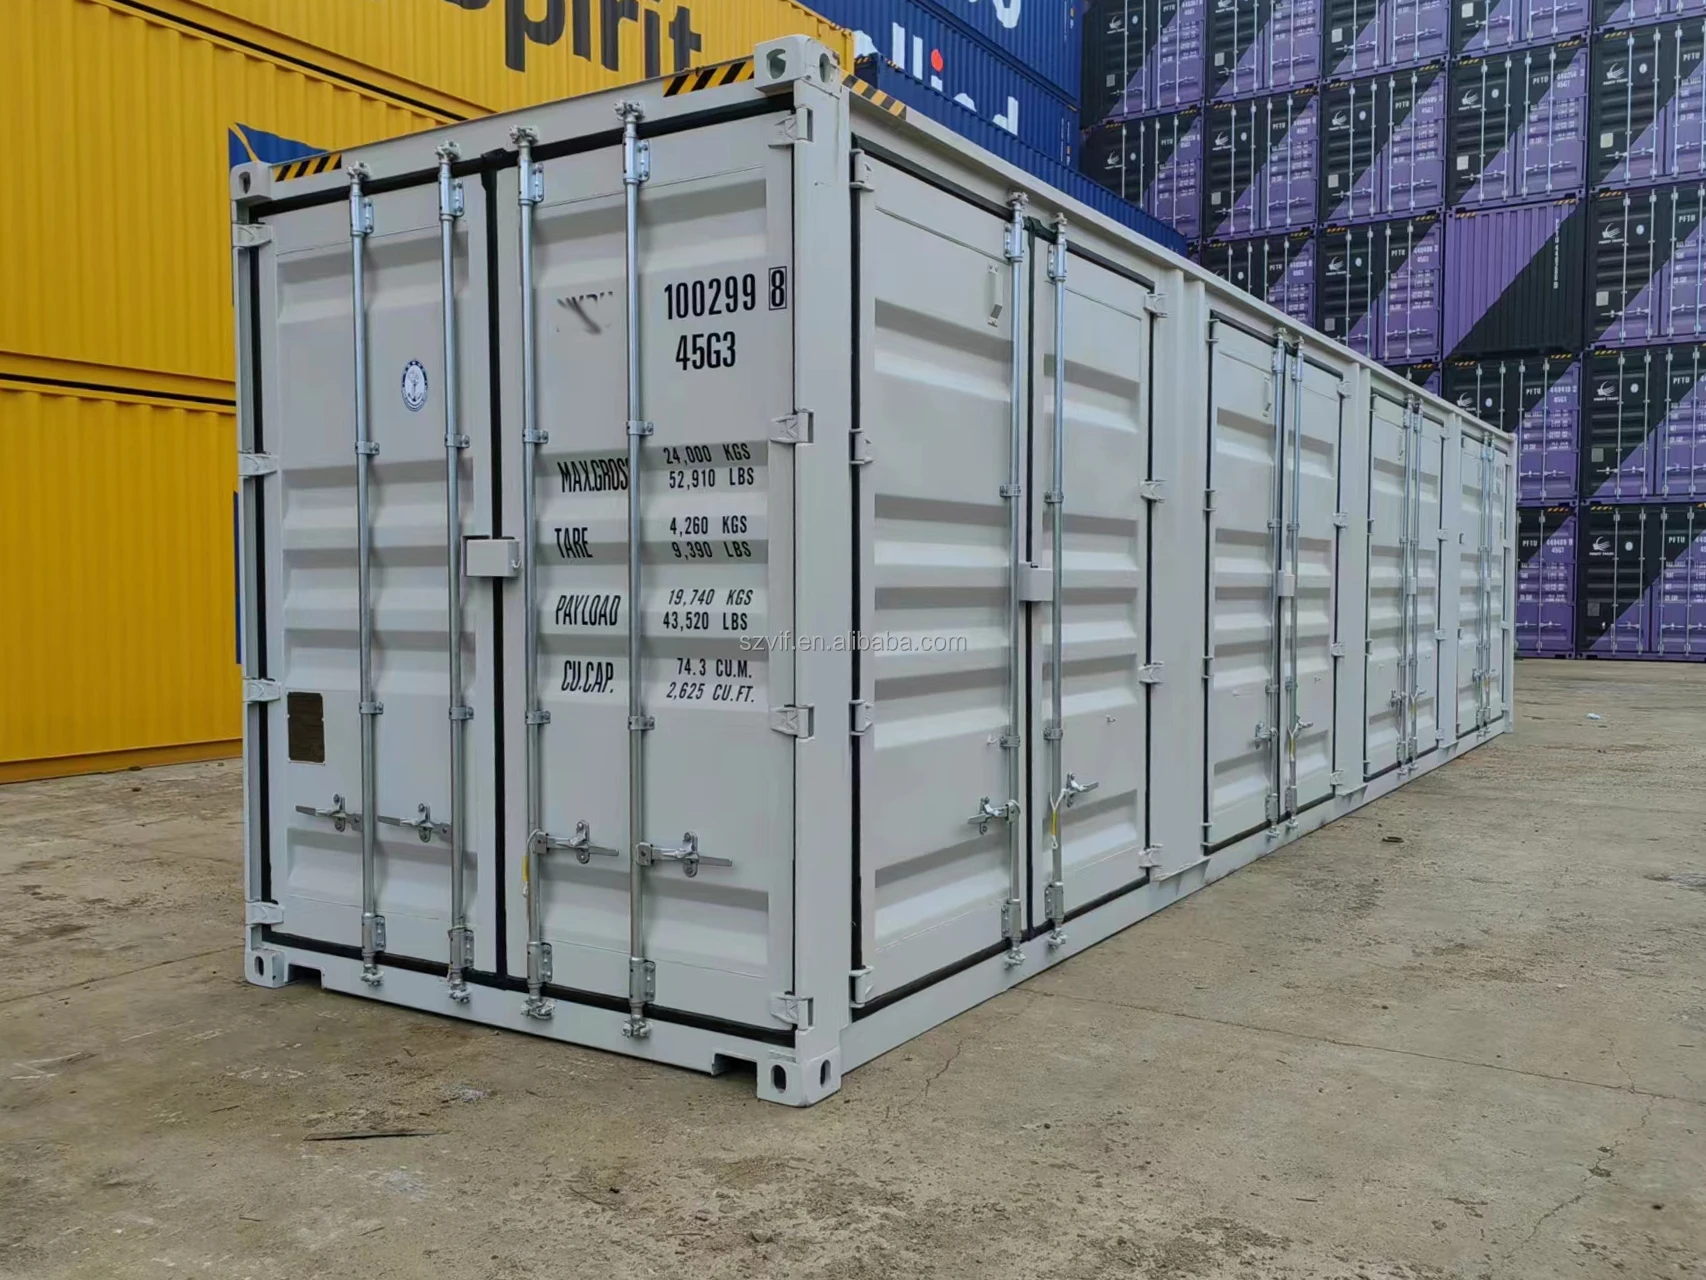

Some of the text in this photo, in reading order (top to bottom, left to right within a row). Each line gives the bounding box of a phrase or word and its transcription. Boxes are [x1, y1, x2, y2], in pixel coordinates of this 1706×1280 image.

[443, 0, 702, 80] pirit
[664, 273, 756, 320] 100299
[769, 266, 787, 310] 8
[675, 331, 736, 371] 45G3
[663, 443, 751, 465] 24,000 KGS
[557, 456, 630, 493] MAX.GROS
[669, 466, 754, 490] 52,910 LBS
[669, 515, 748, 537] 4,260 KGS
[554, 526, 593, 559] TARE
[671, 541, 751, 561] 9,390 LBS
[668, 588, 753, 607] 19,740 KGS
[555, 594, 621, 627] PAYLOAD
[662, 611, 748, 632] 43,520 LBS
[561, 660, 614, 694] CU.CAP.
[676, 657, 707, 677] 74.3
[666, 681, 705, 701] 2,625
